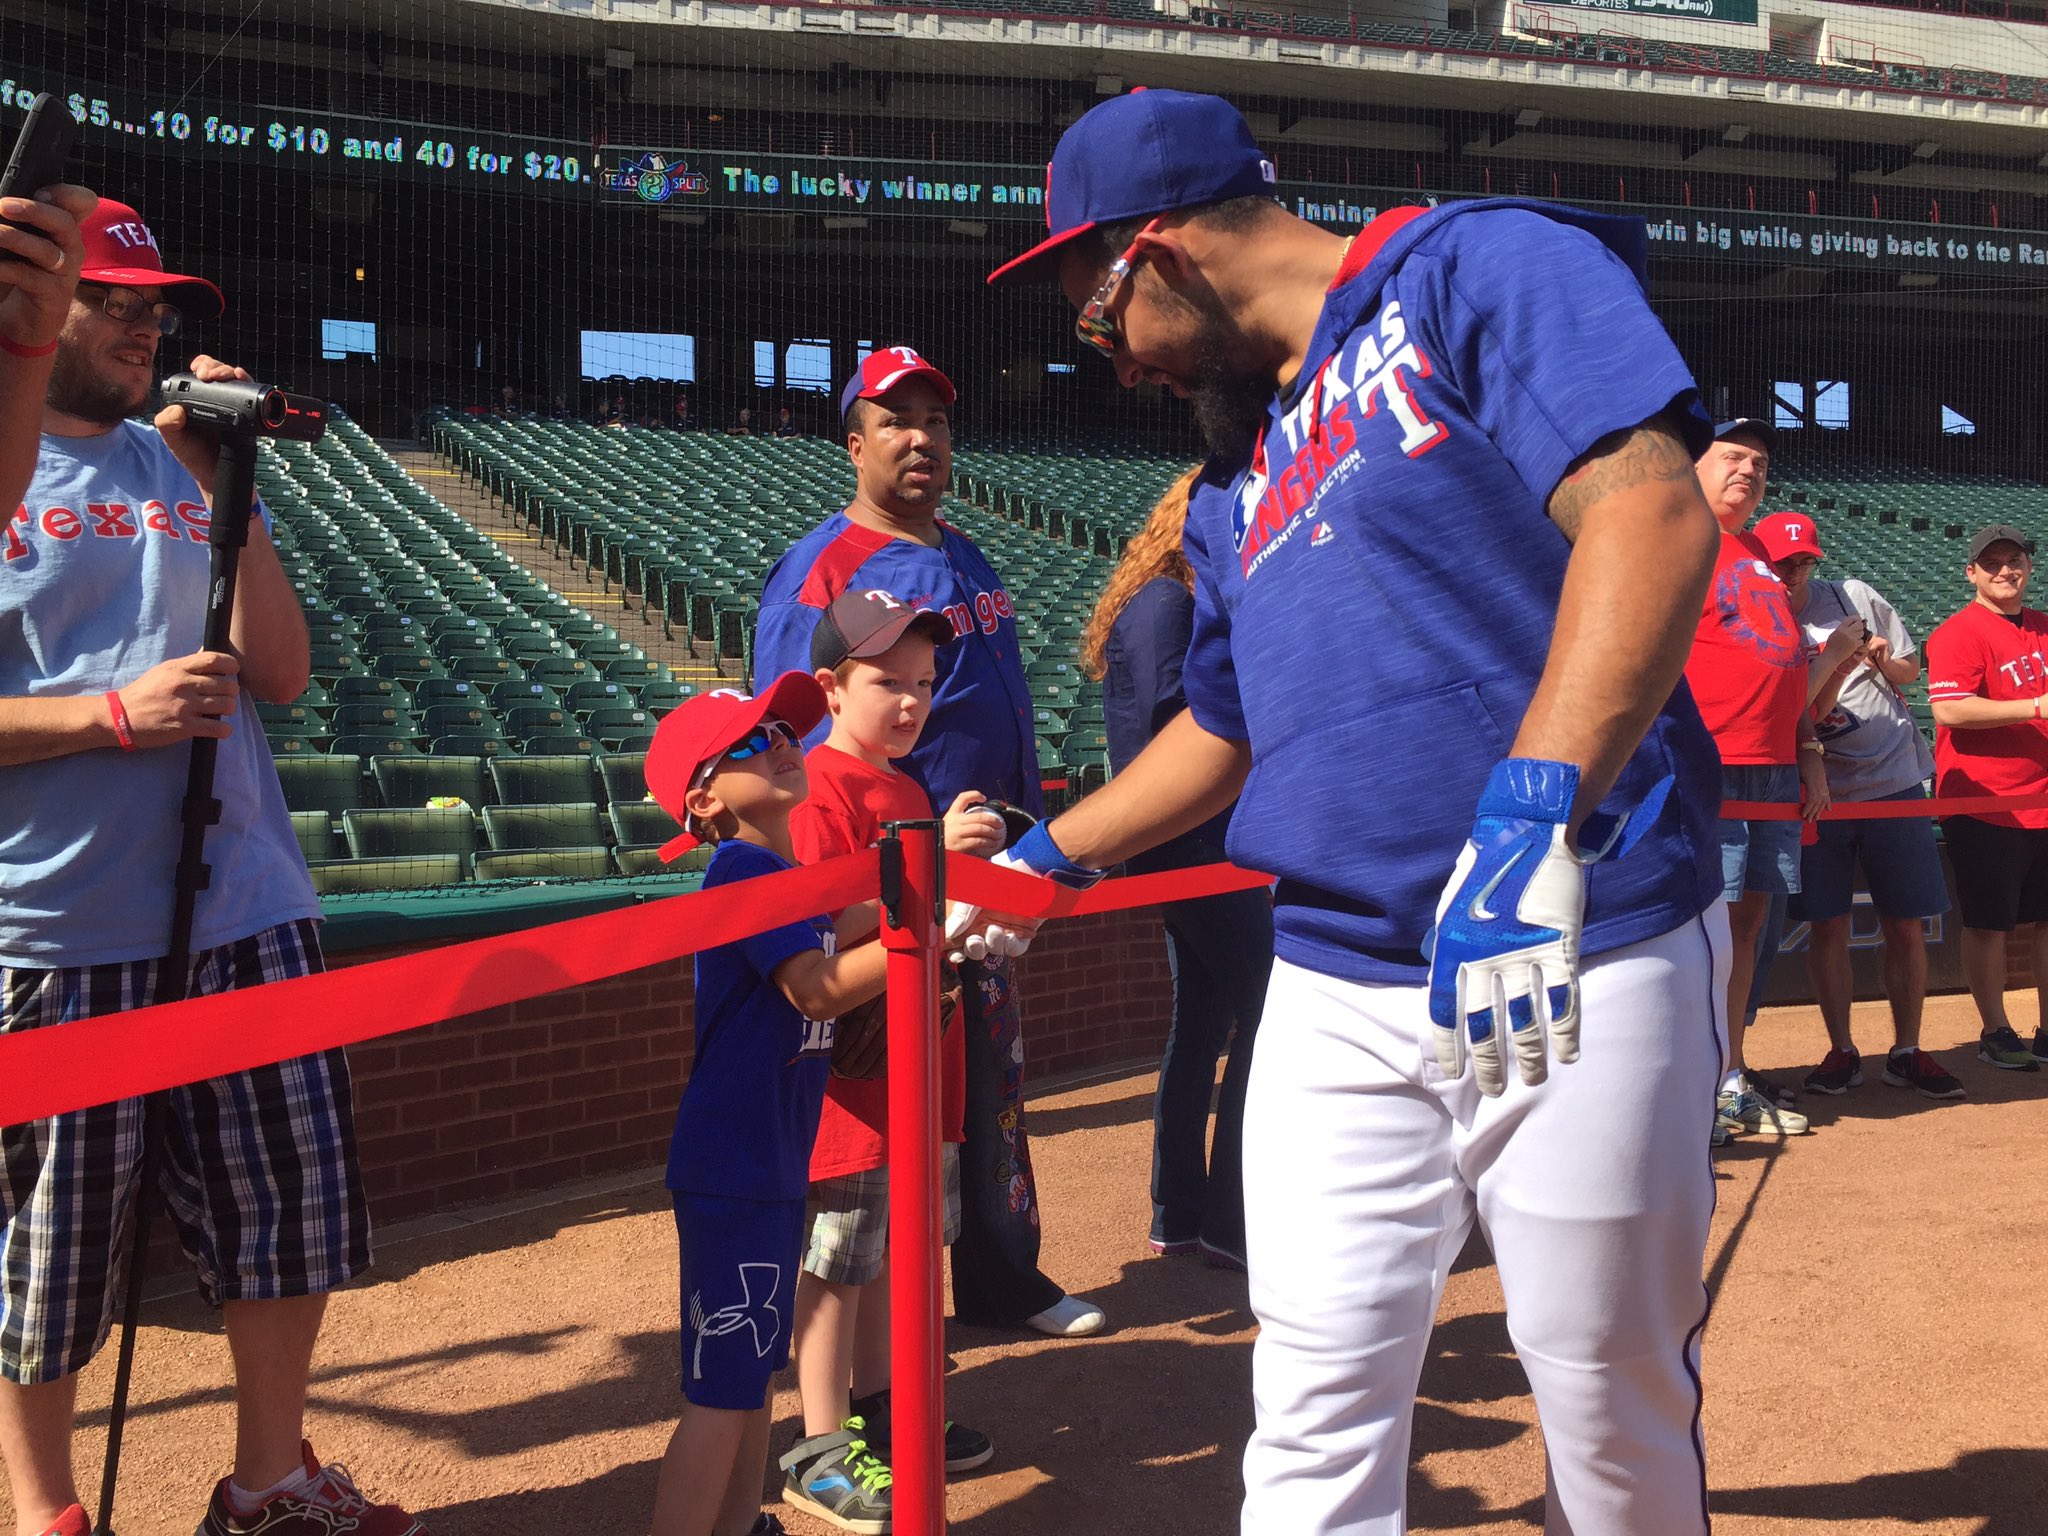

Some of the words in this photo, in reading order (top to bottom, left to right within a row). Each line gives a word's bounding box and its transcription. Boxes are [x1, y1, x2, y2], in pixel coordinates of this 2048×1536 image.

[0, 79, 36, 111] fo
[204, 115, 255, 146] for
[268, 121, 330, 155] $10
[343, 136, 403, 163] and
[415, 139, 456, 169] 40
[467, 144, 513, 175] for
[524, 150, 591, 184] $20.
[603, 173, 639, 188] TEXAS
[672, 176, 704, 191] SPLIT
[723, 166, 780, 195] The
[791, 170, 871, 204] lucky
[881, 175, 982, 203] winner
[992, 184, 1048, 205] ann
[1298, 197, 1377, 227] inning
[1645, 219, 1688, 242] win
[1696, 221, 1732, 250] big
[1739, 225, 1803, 249] while
[1811, 230, 1879, 259] giving
[1887, 234, 1940, 258] back
[1947, 238, 1969, 259] to
[1977, 240, 2011, 263] the
[2019, 243, 2048, 265] Ra
[889, 346, 919, 366] T
[1280, 300, 1407, 457] TEXAS
[1356, 342, 1450, 459] T
[1245, 514, 1302, 581] AUTHENTIC
[1304, 449, 1361, 519] CLECTION
[1785, 523, 1802, 541] T
[864, 589, 902, 613] T
